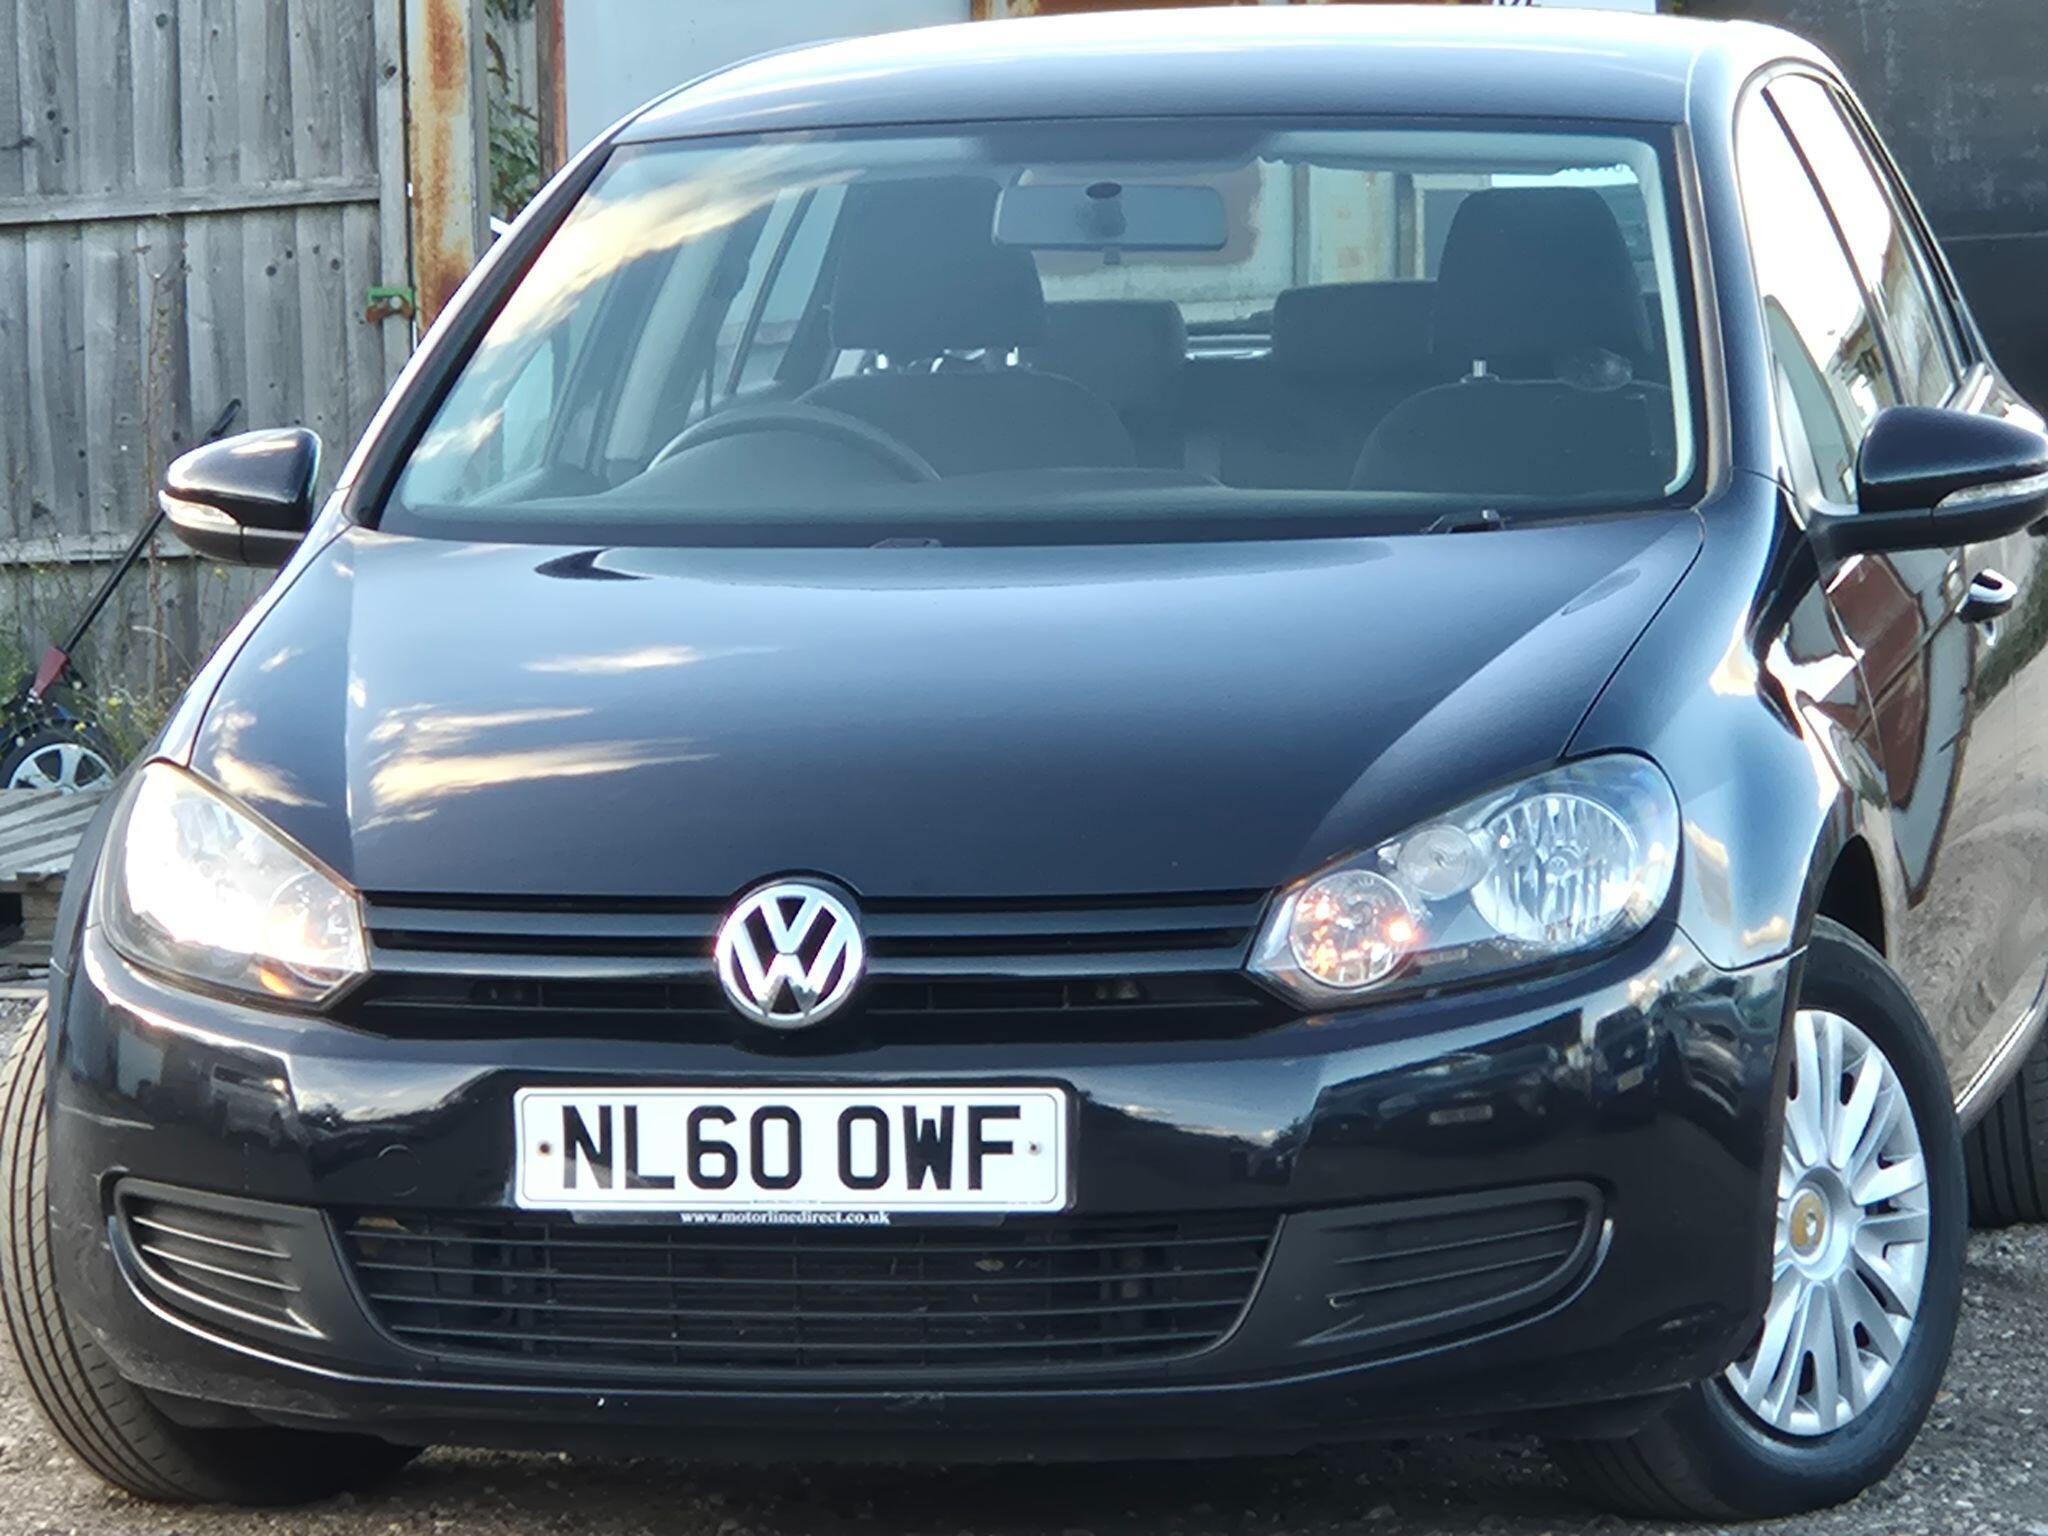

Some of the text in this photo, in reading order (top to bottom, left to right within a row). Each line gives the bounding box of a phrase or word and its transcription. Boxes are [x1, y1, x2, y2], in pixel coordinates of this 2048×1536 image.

[560, 1104, 1022, 1191] NL60 OWF
[680, 1210, 891, 1226] www.motorlinedirect.co.uk
